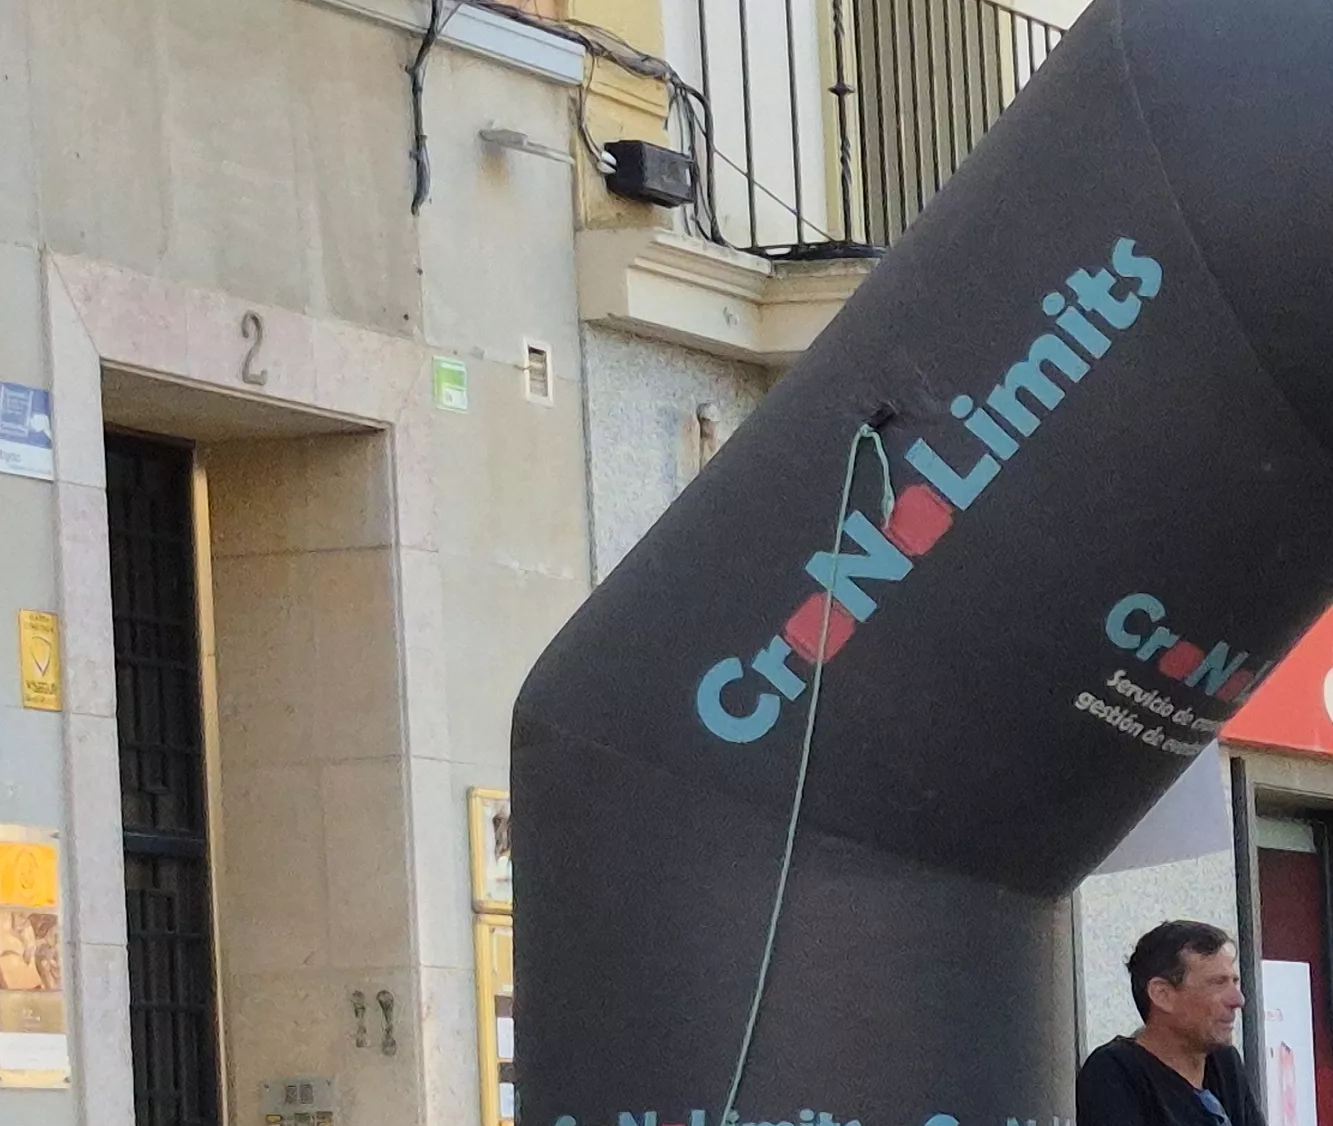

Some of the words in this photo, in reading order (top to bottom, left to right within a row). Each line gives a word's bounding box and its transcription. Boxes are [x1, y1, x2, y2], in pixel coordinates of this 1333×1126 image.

[240, 310, 269, 387] 2
[1073, 690, 1145, 738] gestión
[1106, 668, 1175, 718] Servicio
